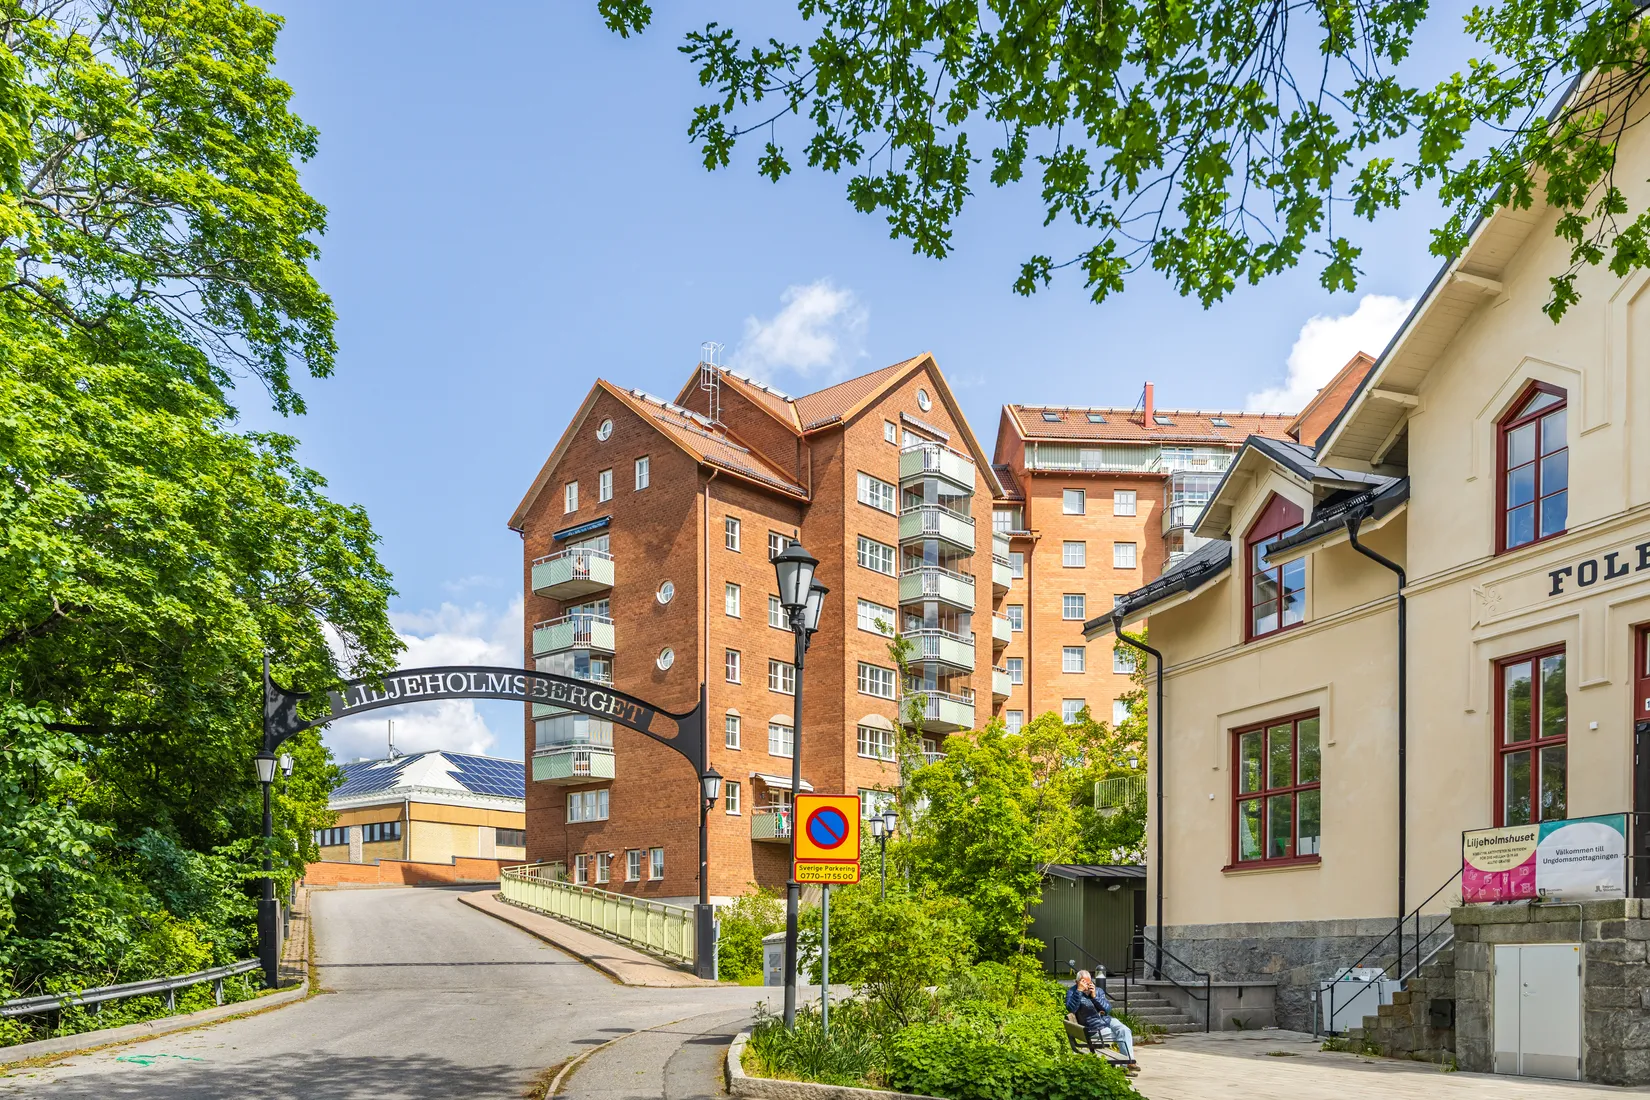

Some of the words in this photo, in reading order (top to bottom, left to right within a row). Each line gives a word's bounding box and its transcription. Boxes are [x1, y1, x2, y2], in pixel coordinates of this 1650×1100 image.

[336, 672, 645, 724] LILJEHOLMSBERGET
[1467, 833, 1535, 849] Liljeholmshuset
[1555, 846, 1594, 856] Välkommen
[1543, 853, 1619, 865] Ungdomsmottagningen
[800, 872, 831, 880] 0770-17
